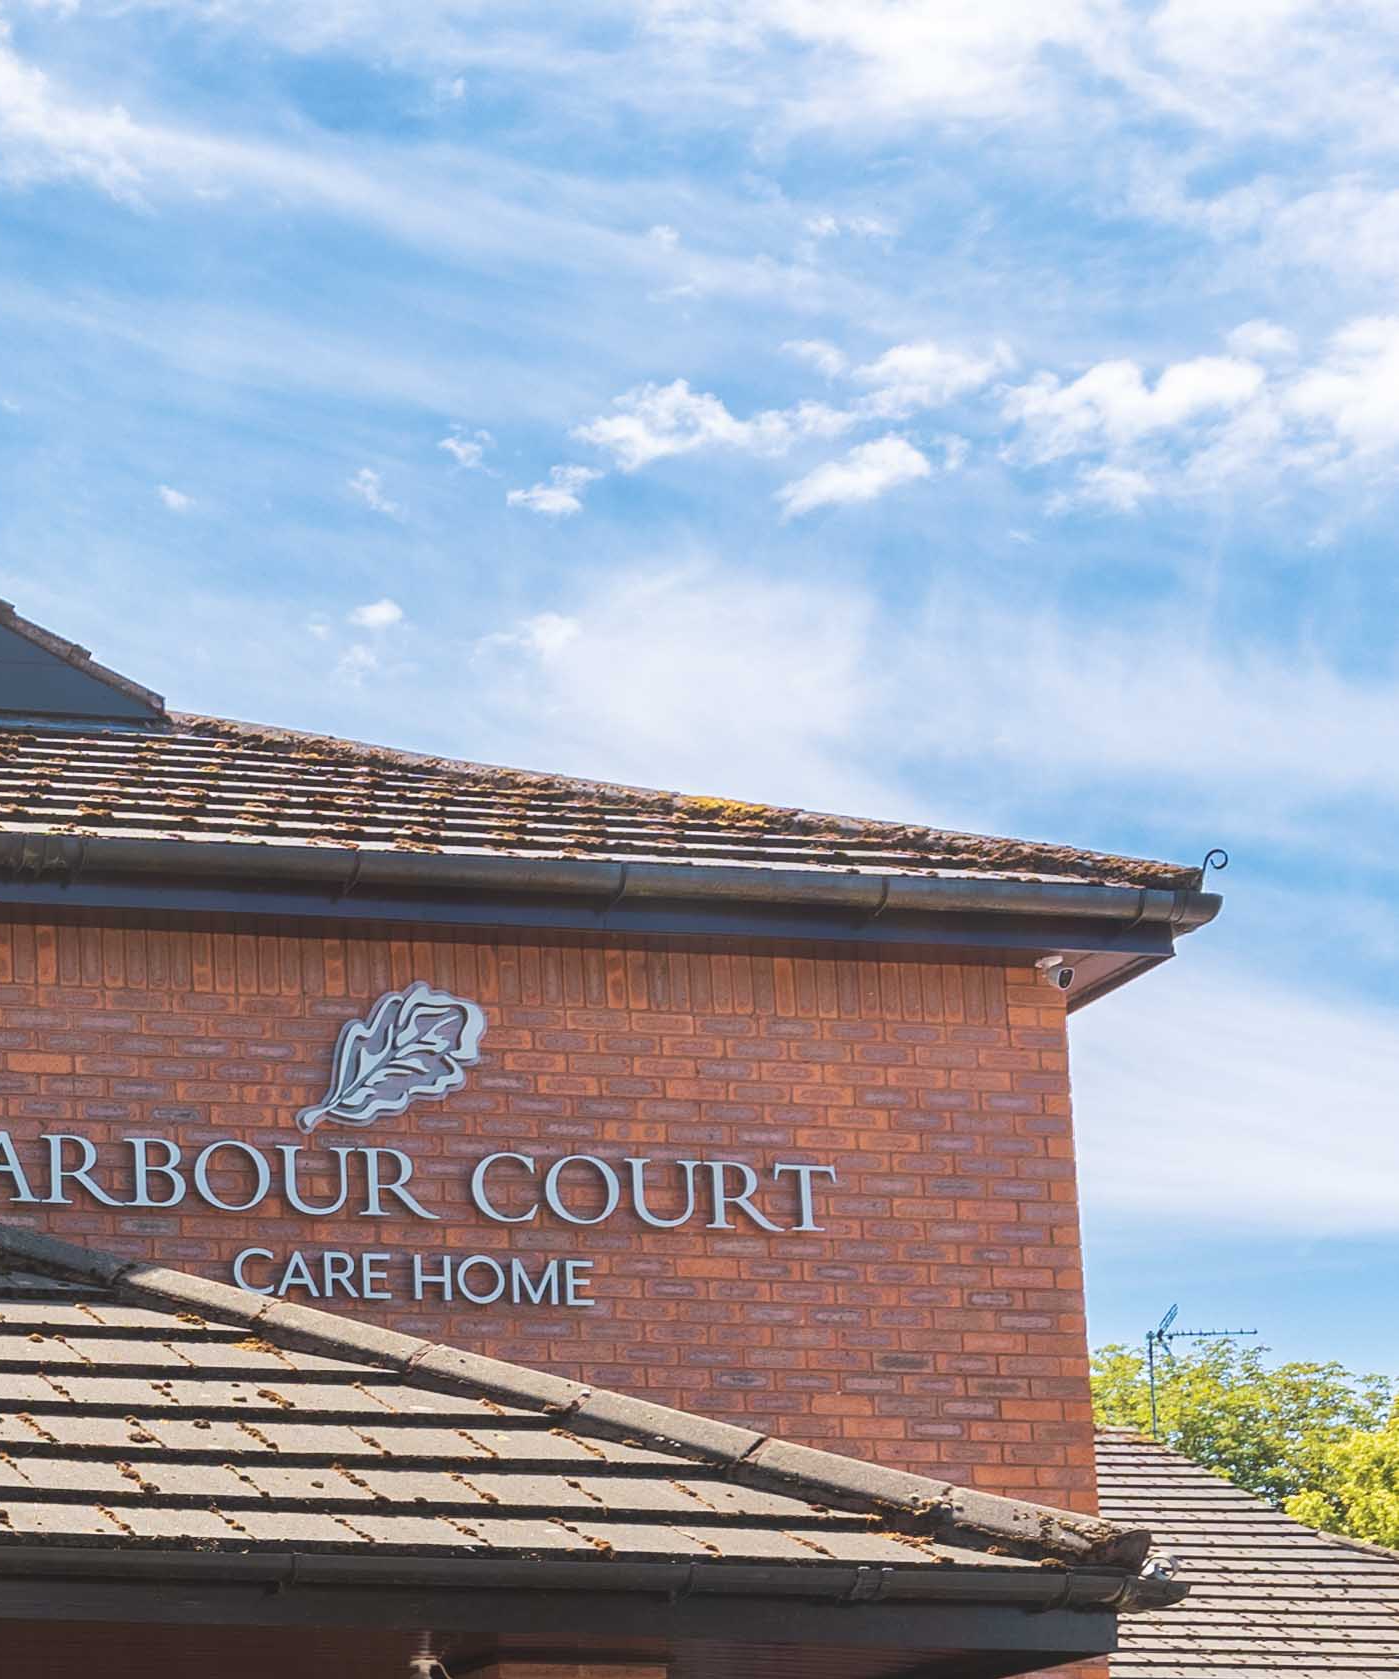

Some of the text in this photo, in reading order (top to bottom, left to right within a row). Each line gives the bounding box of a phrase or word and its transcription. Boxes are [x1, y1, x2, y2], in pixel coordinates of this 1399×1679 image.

[471, 1152, 837, 1232] COURT
[233, 1247, 596, 1306] CARE HOME
